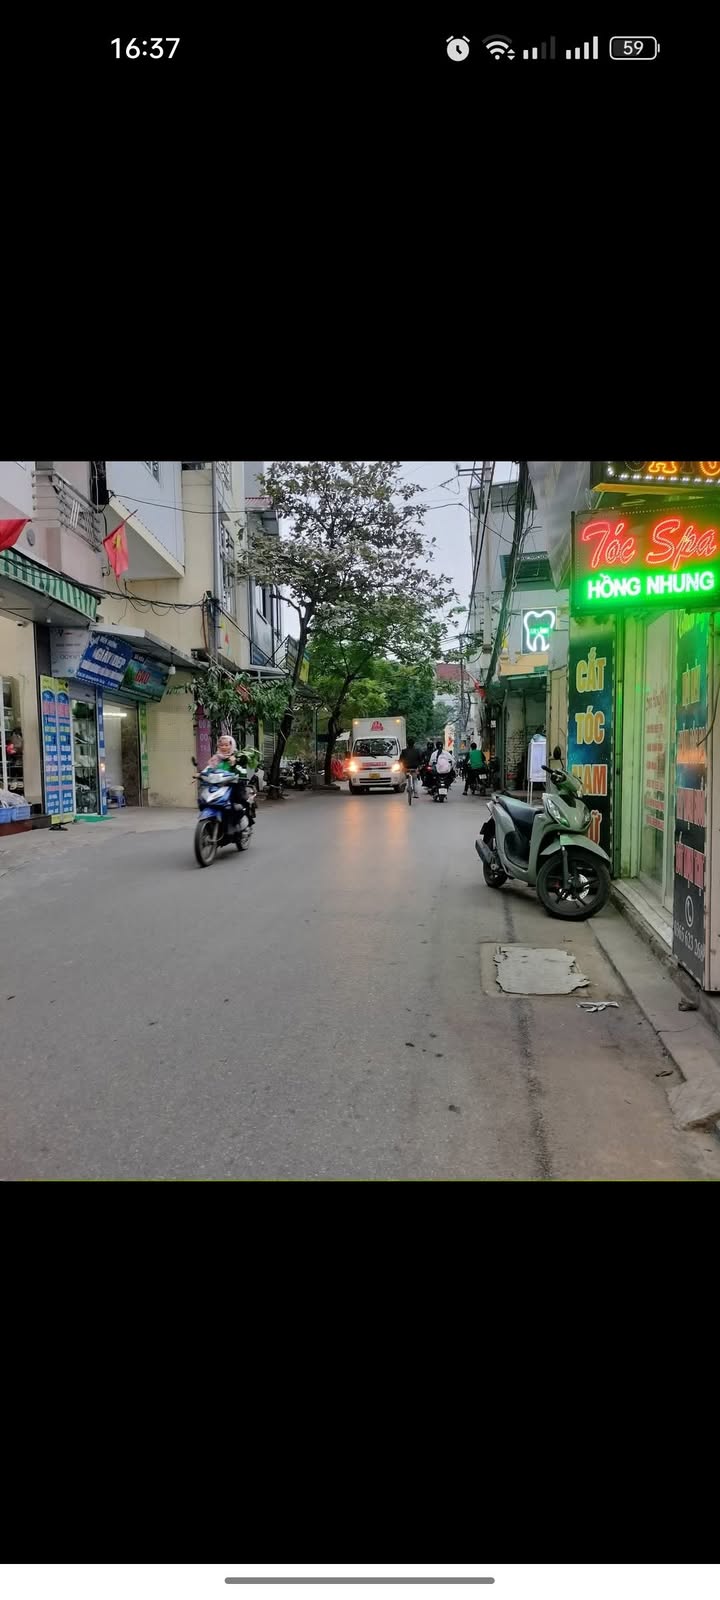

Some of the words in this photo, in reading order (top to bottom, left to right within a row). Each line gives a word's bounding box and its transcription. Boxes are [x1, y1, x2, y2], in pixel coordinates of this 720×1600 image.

[581, 520, 636, 568] Tóc
[646, 518, 718, 571] Spa
[587, 573, 641, 600] HỒNG
[646, 571, 715, 595] NHUNG
[575, 646, 607, 693] CẮT
[575, 705, 606, 745] TÓC
